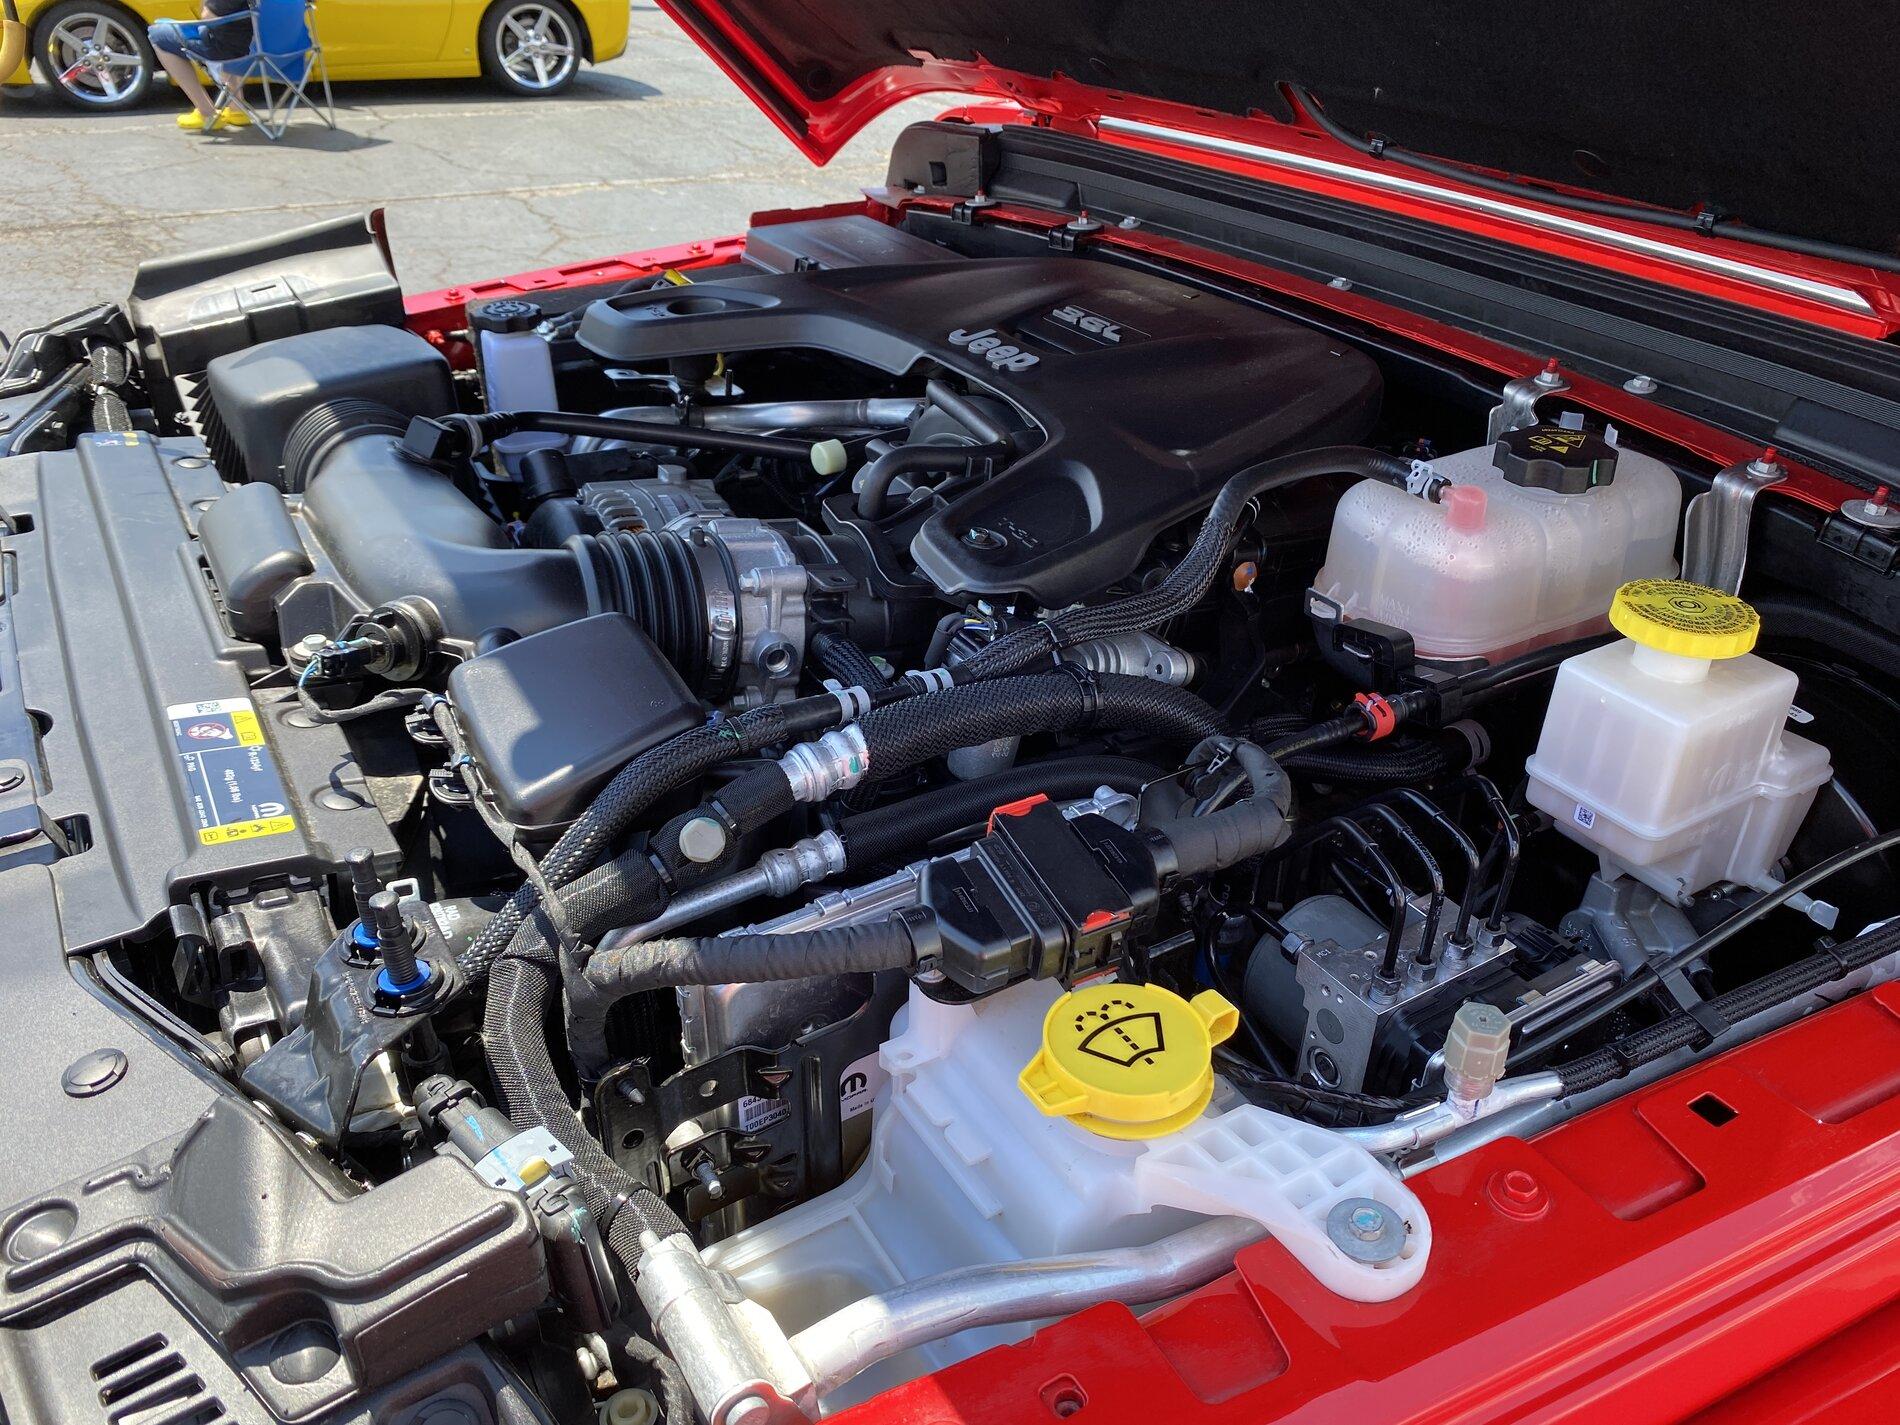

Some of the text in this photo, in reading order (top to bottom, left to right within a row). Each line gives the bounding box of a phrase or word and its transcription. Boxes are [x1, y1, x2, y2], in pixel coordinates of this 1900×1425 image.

[948, 328, 1040, 372] Jeep
[447, 904, 461, 920] RAD
[743, 1096, 762, 1108] 684
